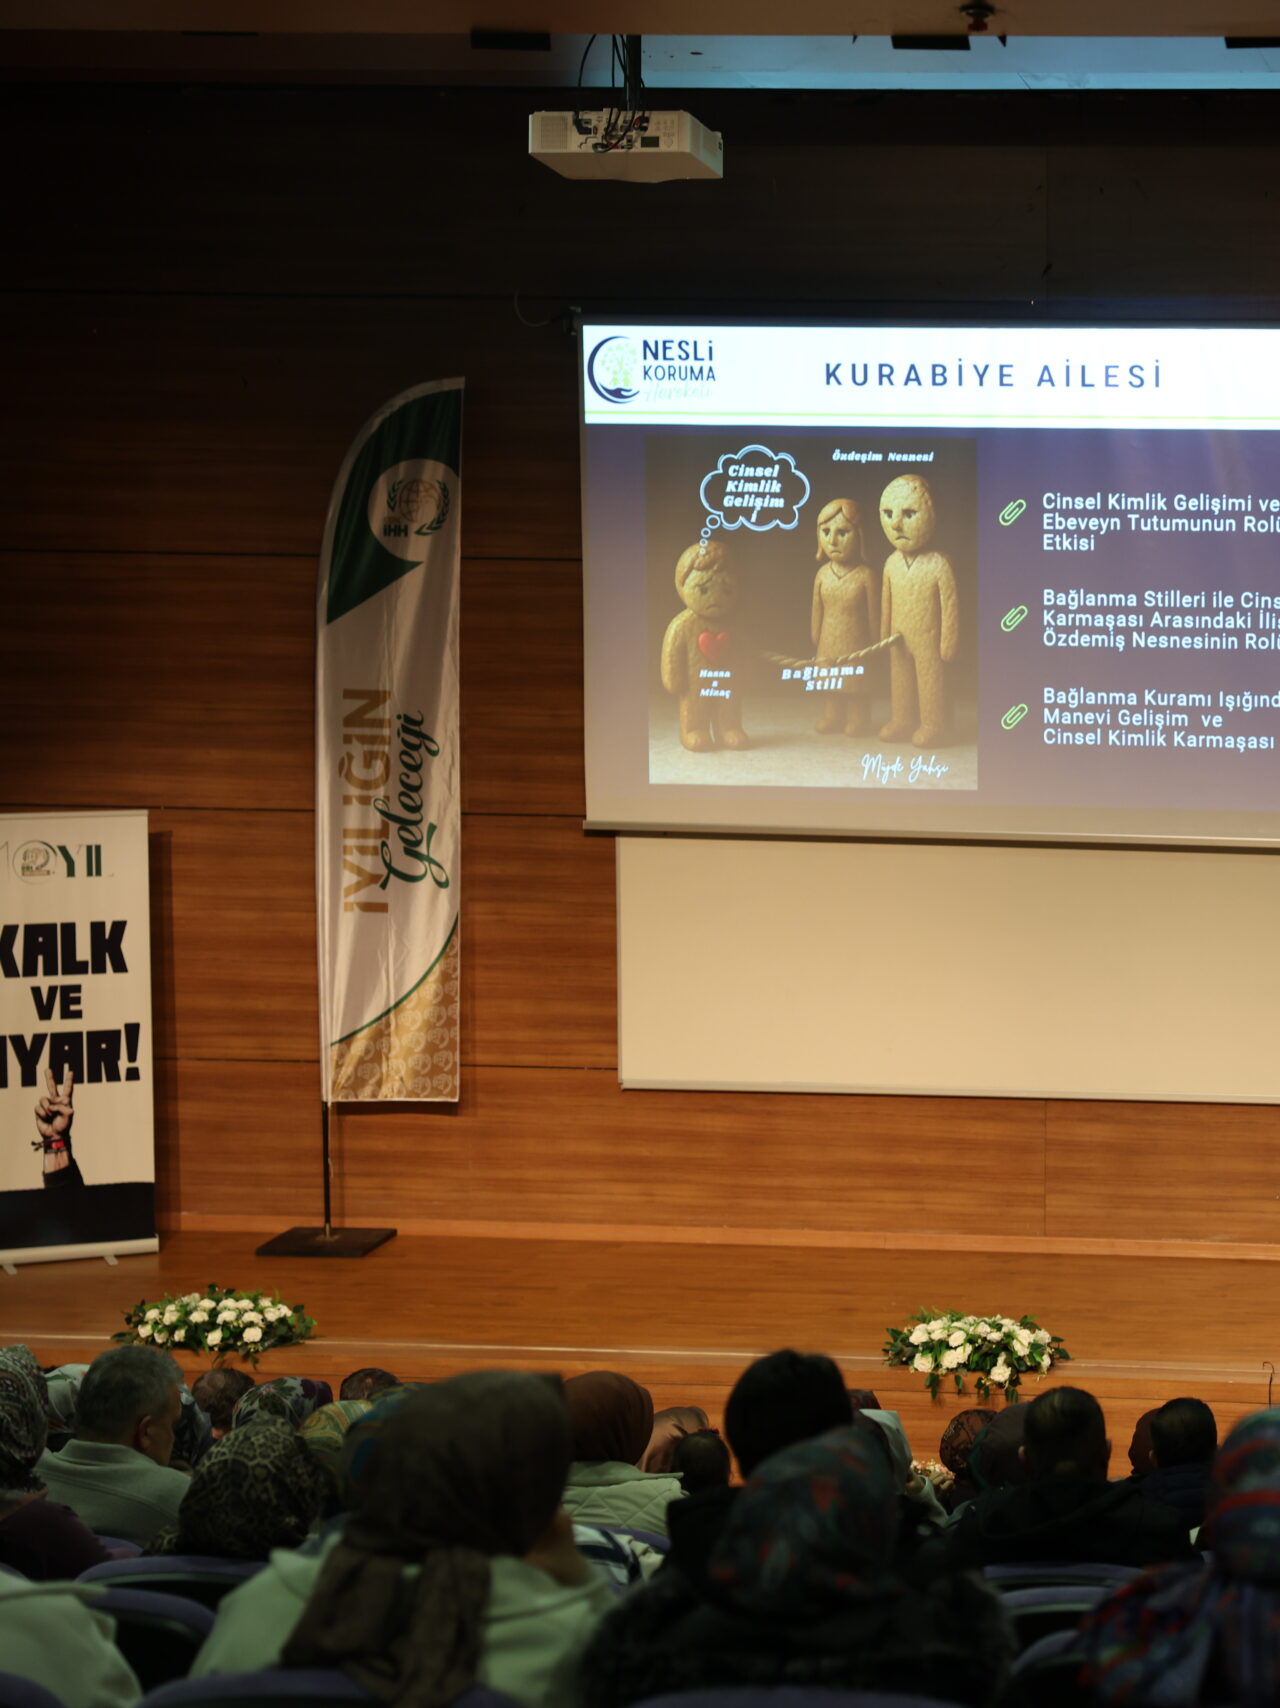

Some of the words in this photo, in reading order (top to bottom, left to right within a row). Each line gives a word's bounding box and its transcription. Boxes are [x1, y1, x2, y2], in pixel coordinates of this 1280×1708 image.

[643, 365, 716, 382] KORUMA
[825, 358, 1014, 386] KURABİYE
[1037, 359, 1160, 388] AİLESİ
[728, 464, 780, 478] Cinsel
[726, 480, 782, 493] Kimlik
[723, 495, 784, 510] Gelişim
[1042, 492, 1101, 510] Cinsel
[1108, 492, 1167, 510] Kimlik
[1173, 493, 1251, 515] Gelişimi
[1258, 498, 1280, 512] ve
[1043, 512, 1121, 535] Ebeveyn
[1127, 514, 1236, 532] Tutumunun
[1043, 533, 1095, 551] Etkisi
[1043, 588, 1137, 610] Bağlanma
[1144, 589, 1205, 608] Stilleri
[1212, 590, 1234, 608] ile
[1043, 609, 1143, 631] Karmaşası
[1150, 611, 1251, 629] Arasındaki
[1043, 627, 1125, 652] Özdemiş
[1132, 631, 1238, 649] Nesnesinin
[781, 665, 865, 681] Bağlanma
[805, 678, 843, 691] Stili
[1043, 686, 1137, 708] Bağlanma
[1144, 689, 1211, 707] Kuramı
[1043, 707, 1111, 725] Manevi
[1118, 708, 1188, 730] Gelişim
[1201, 714, 1223, 728] ve
[1043, 728, 1101, 745] Cinsel
[1108, 728, 1167, 746] Kimlik
[1173, 730, 1274, 753] Karmaşası
[373, 709, 449, 889] Geleceği
[30, 984, 83, 1021] VE
[0, 1022, 141, 1088] YAR!
